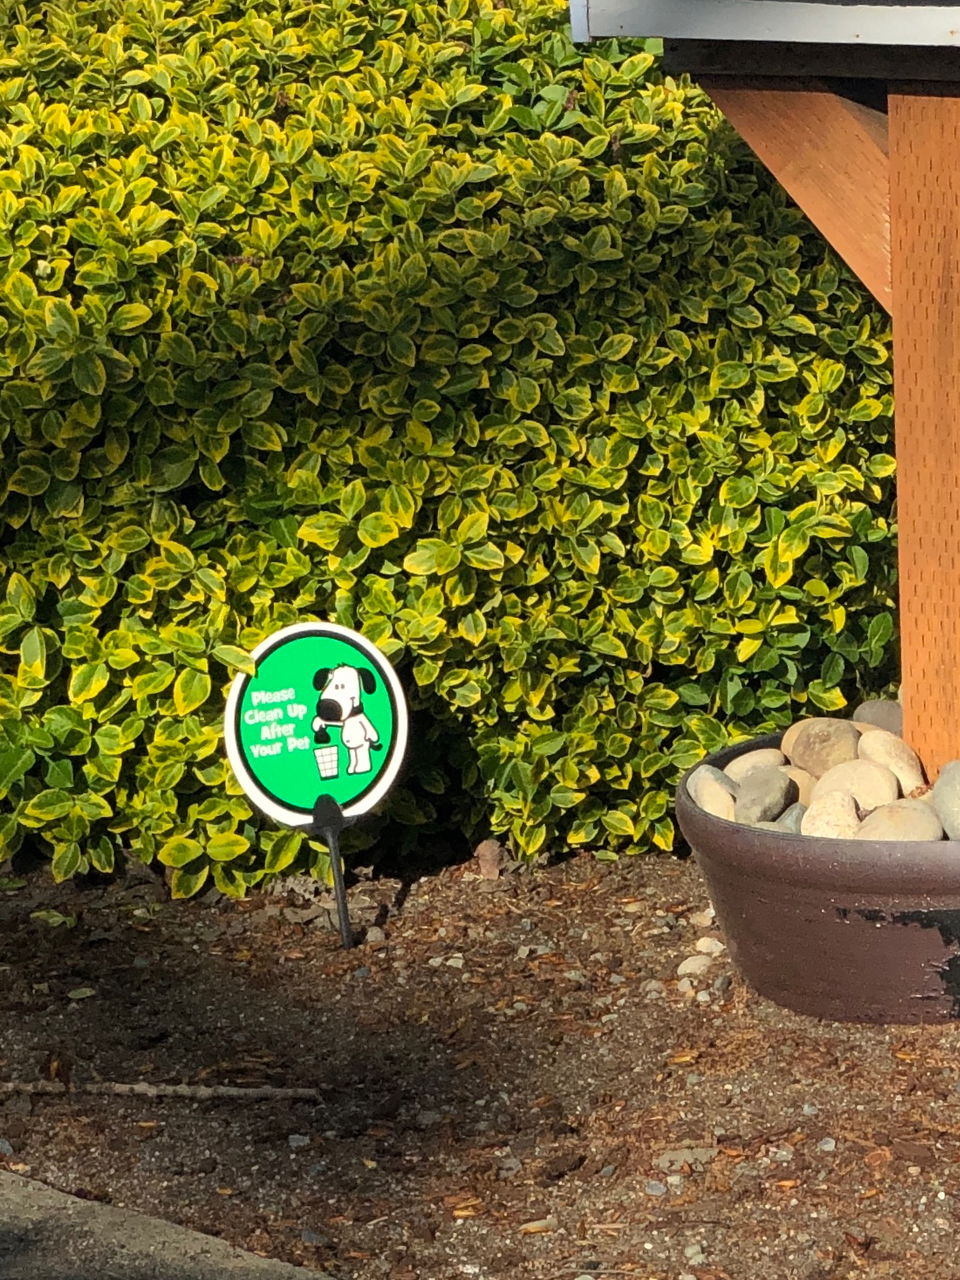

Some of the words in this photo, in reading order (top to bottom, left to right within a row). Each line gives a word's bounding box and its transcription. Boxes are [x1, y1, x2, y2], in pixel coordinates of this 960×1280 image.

[251, 687, 296, 707] Please
[244, 707, 284, 726] Clean
[260, 722, 296, 741] After
[249, 742, 283, 758] Your
[286, 735, 310, 753] Pet
